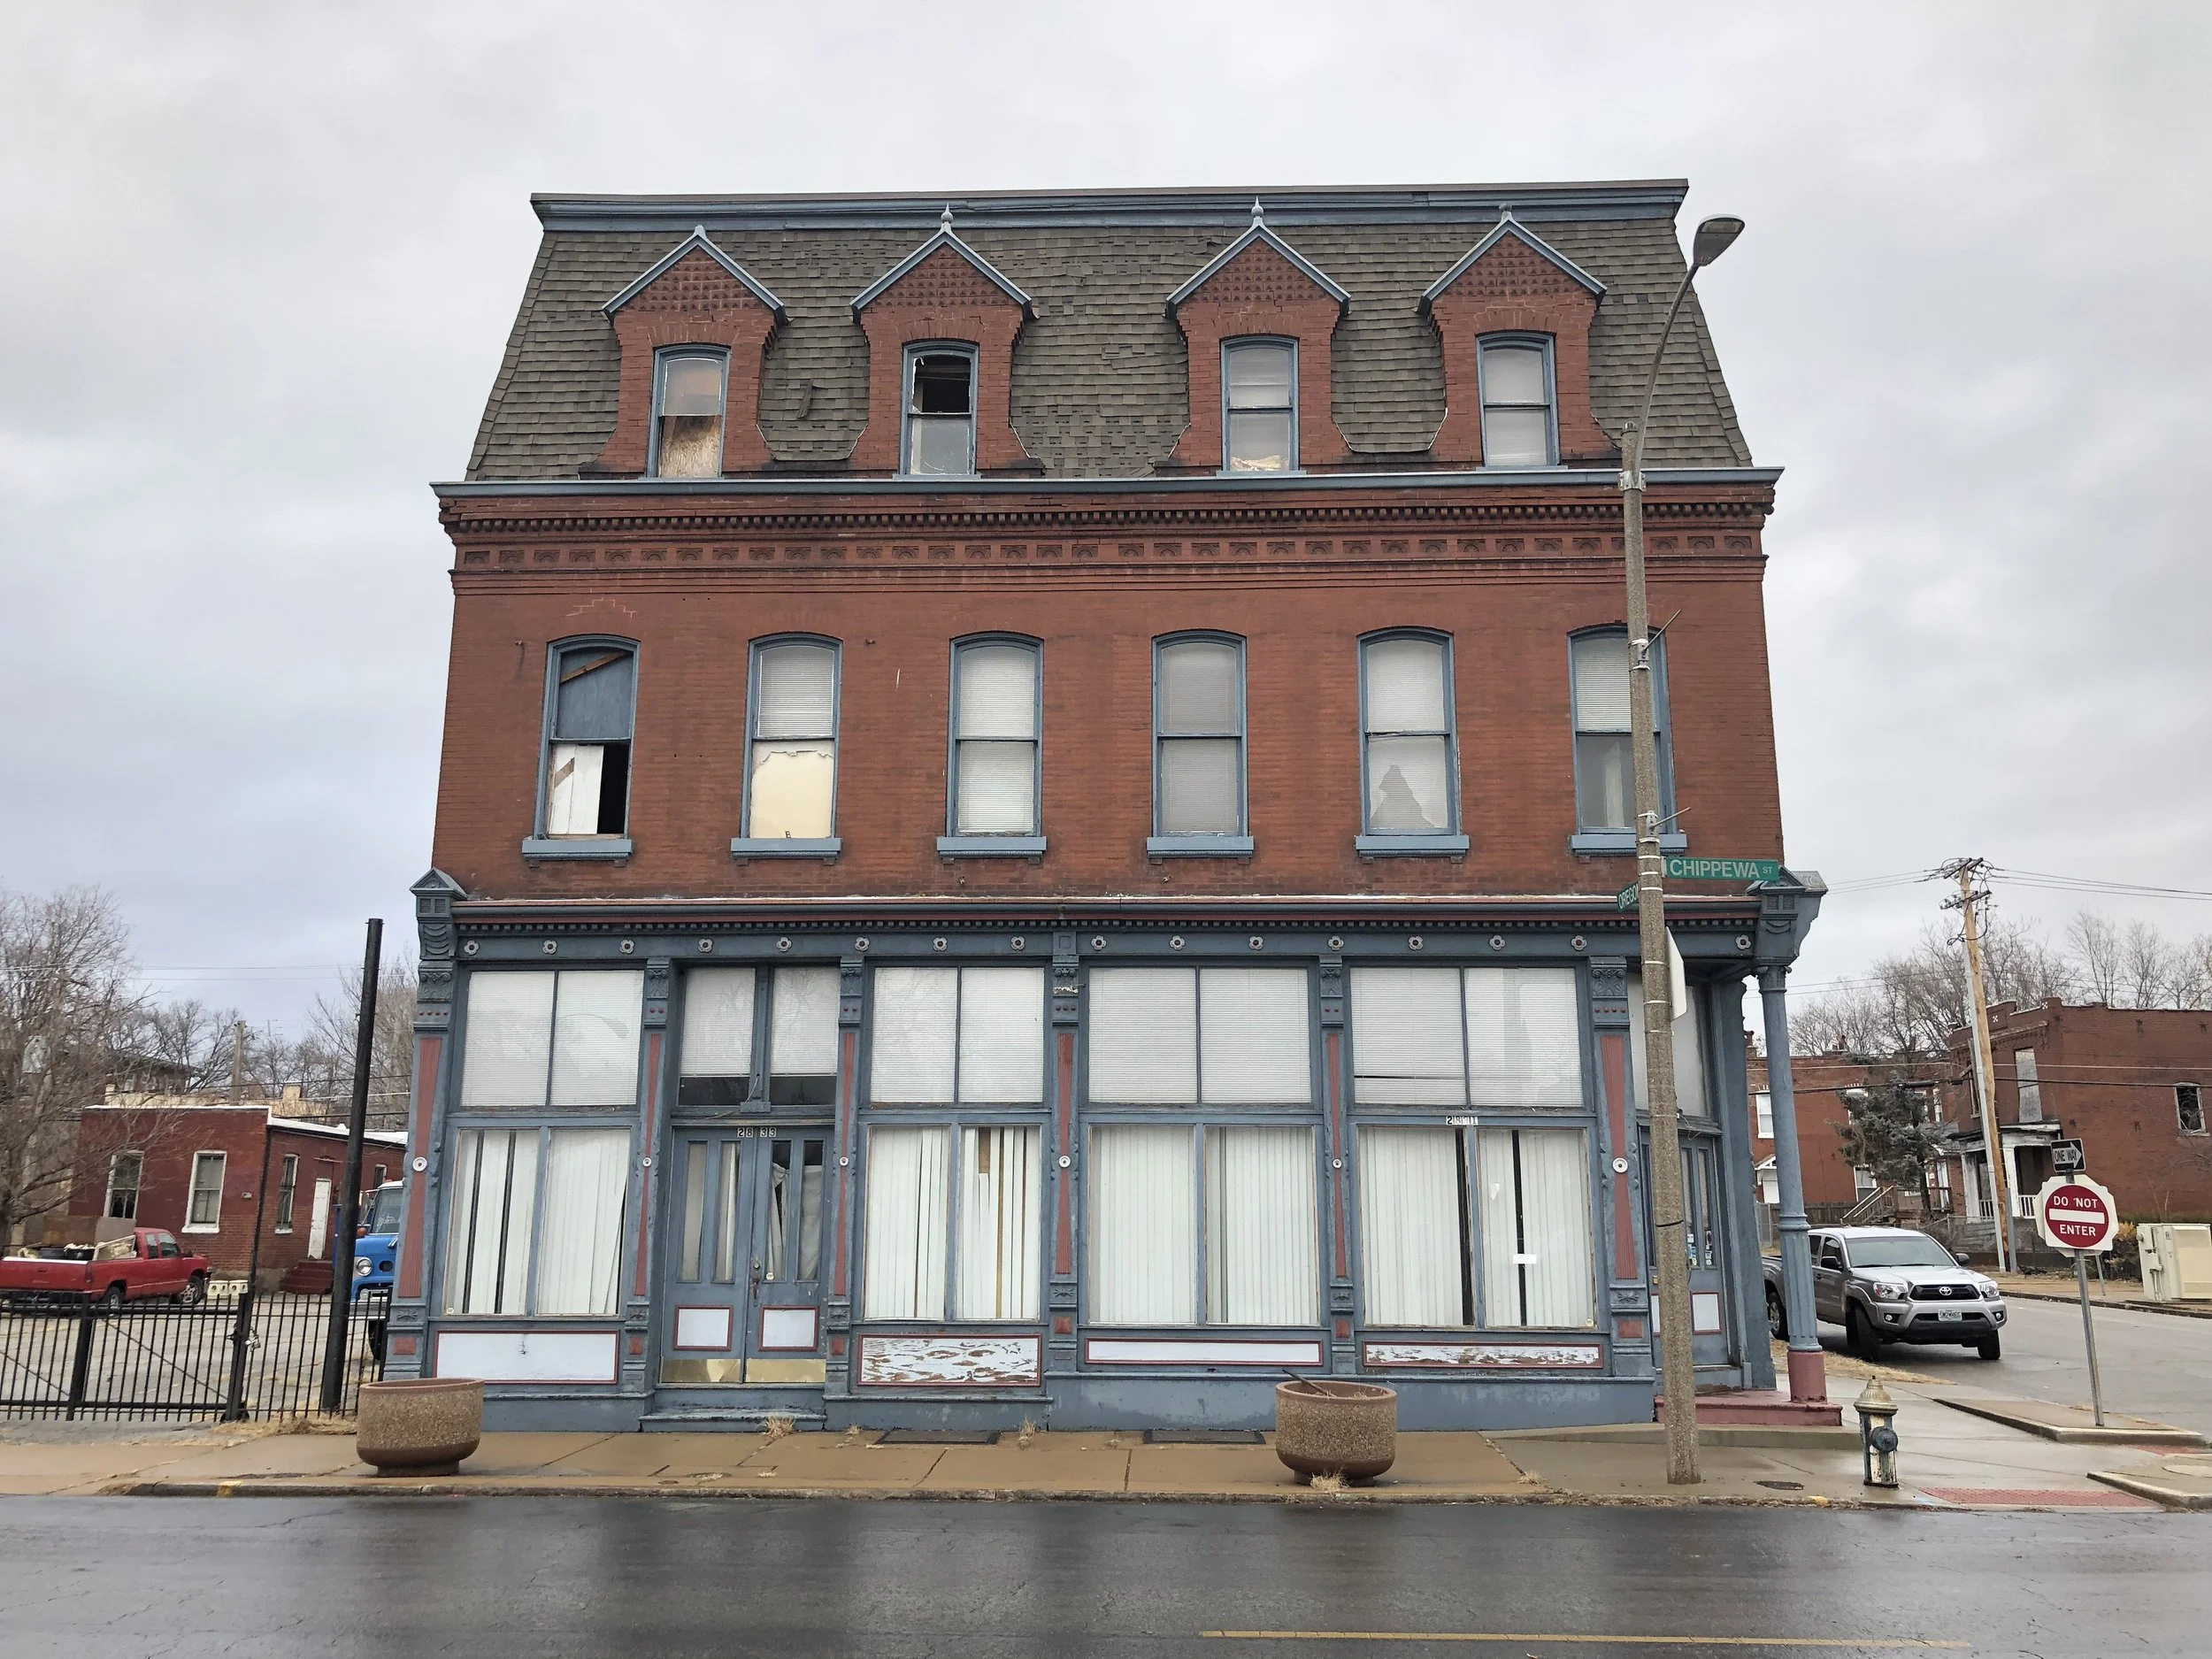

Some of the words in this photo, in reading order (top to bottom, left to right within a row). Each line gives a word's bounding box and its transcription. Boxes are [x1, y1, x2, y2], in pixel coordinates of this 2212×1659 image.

[1669, 859, 1761, 879] CHIPPEWA
[2054, 1149, 2066, 1163] ONE
[2067, 1148, 2078, 1161] WAY
[2053, 1195, 2069, 1207] DO
[2075, 1197, 2098, 1209] NOT
[2059, 1224, 2096, 1237] ENTER
